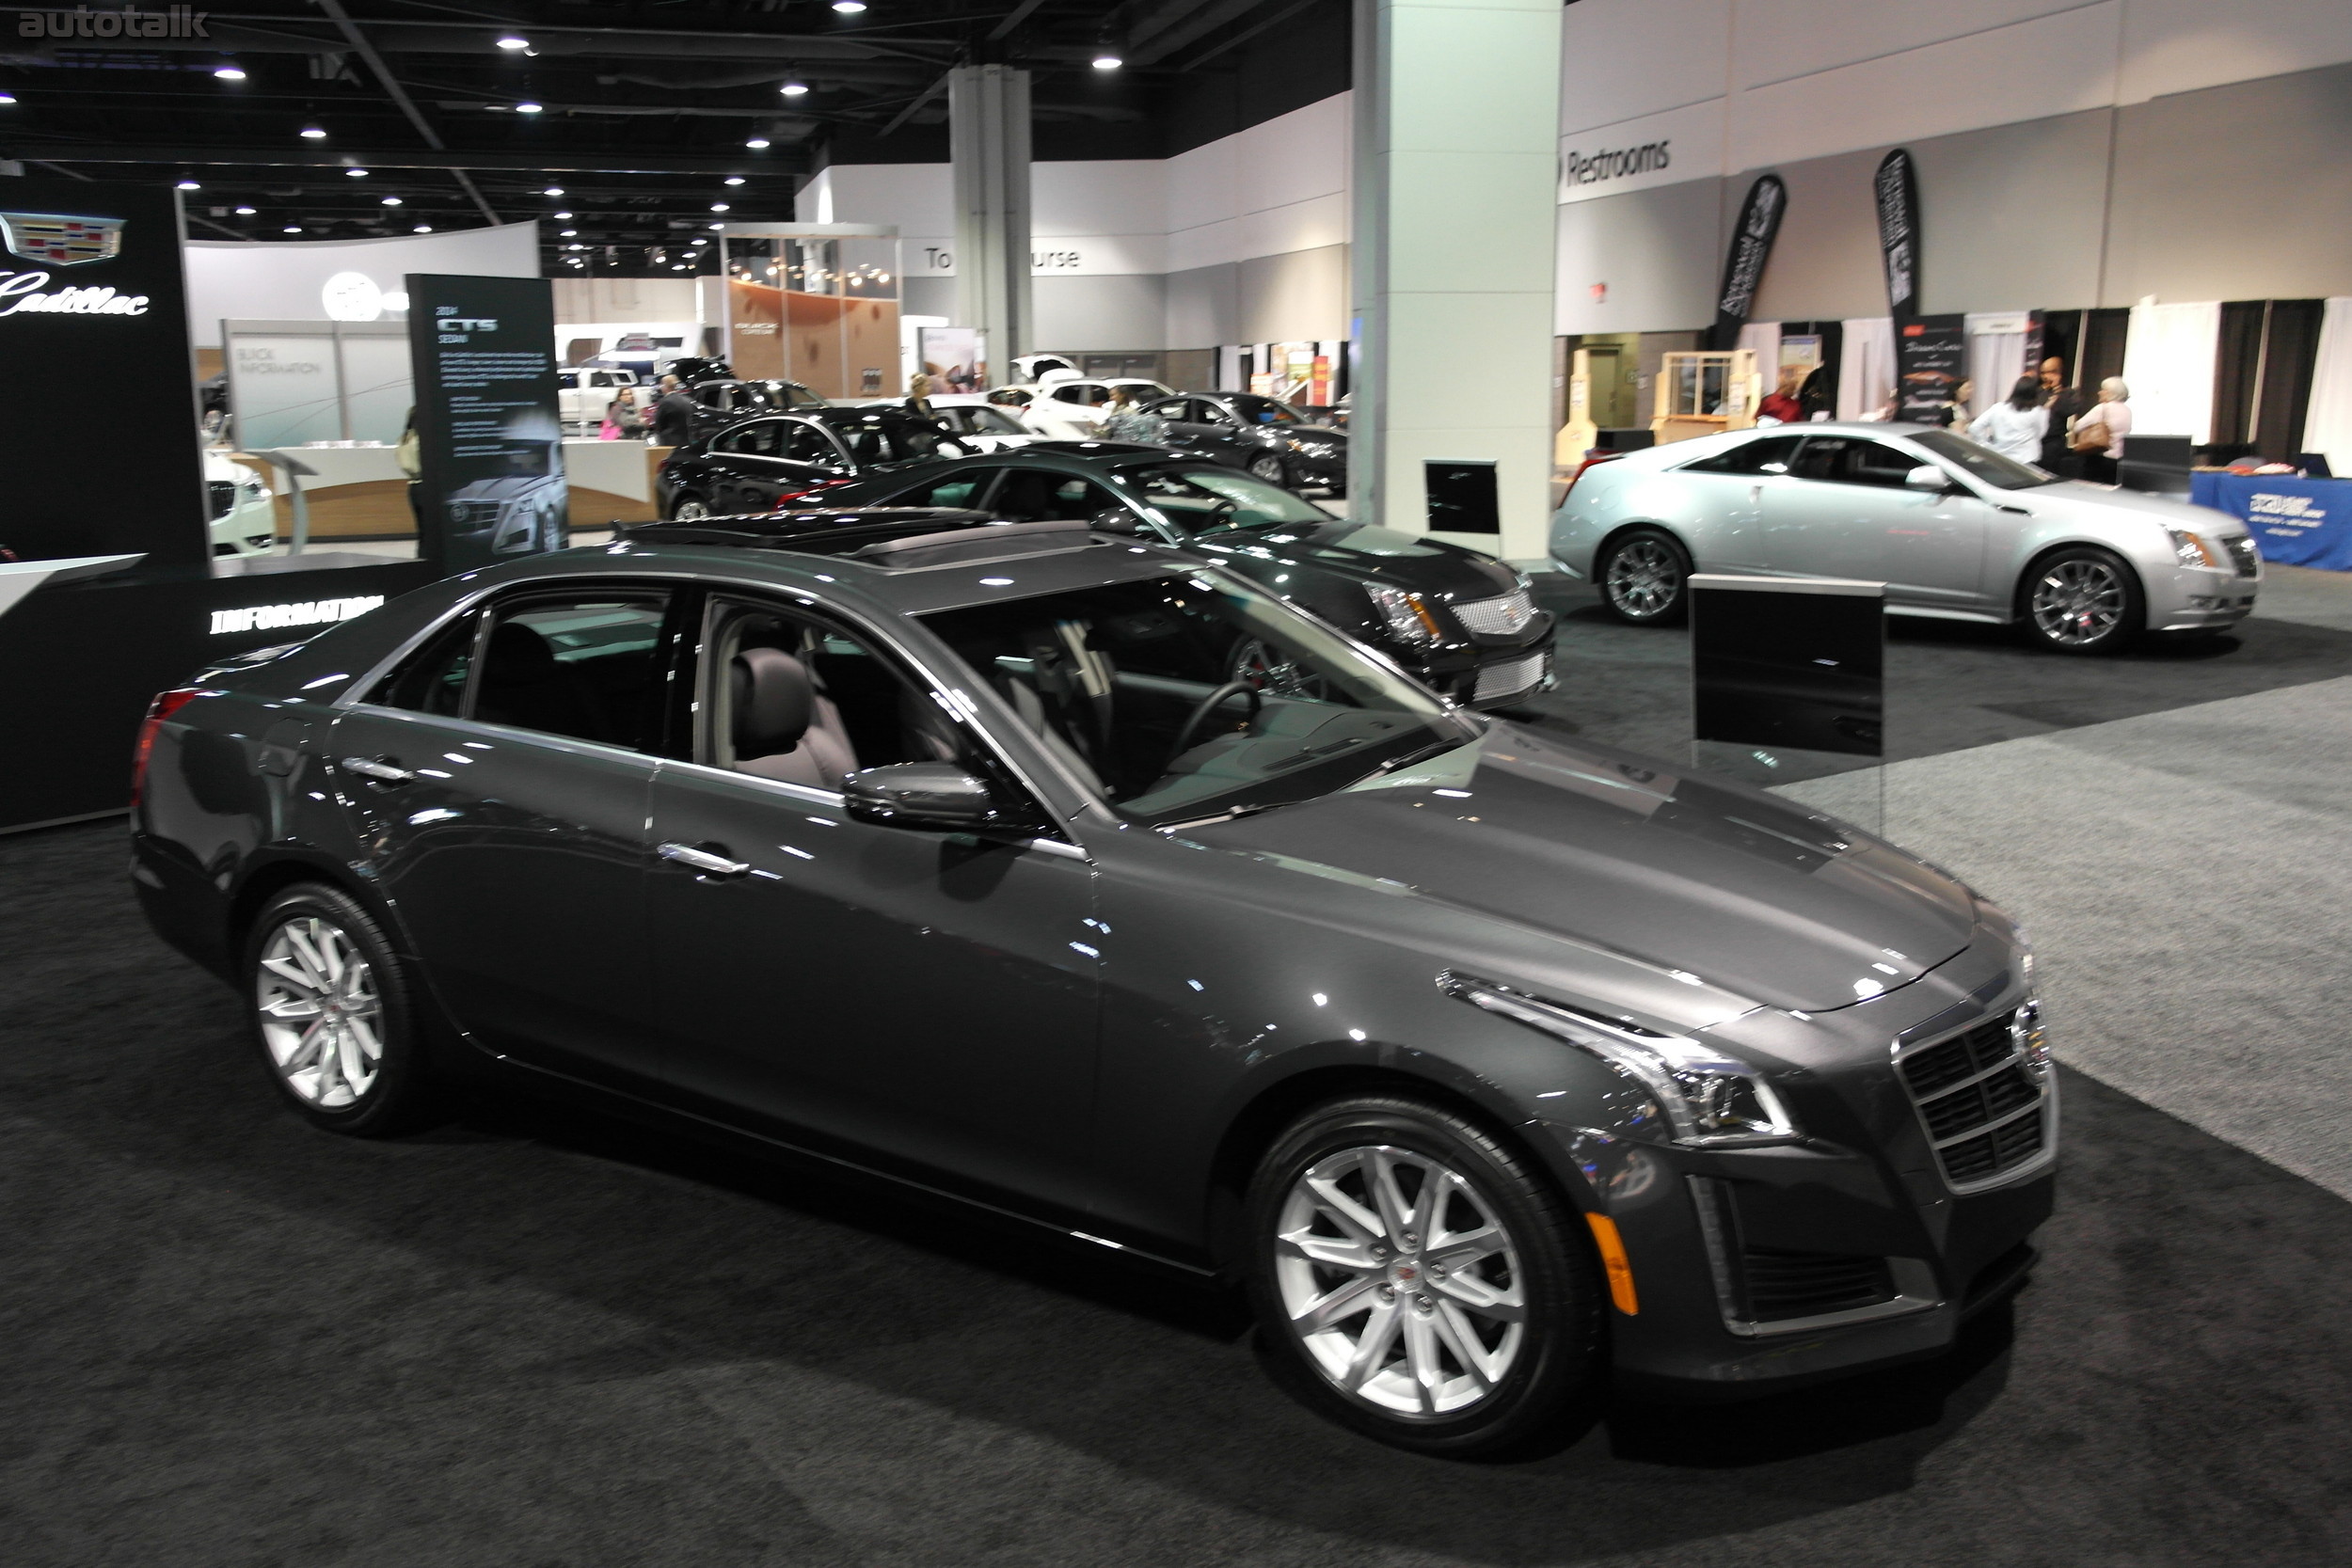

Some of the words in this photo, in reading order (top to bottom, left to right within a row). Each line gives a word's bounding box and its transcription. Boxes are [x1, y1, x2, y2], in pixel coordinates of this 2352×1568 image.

[1567, 140, 1670, 186] Restrooms
[924, 246, 952, 269] To
[1031, 250, 1082, 268] urse
[0, 271, 150, 316] Cadillac
[437, 319, 499, 331] CTS
[437, 334, 469, 344] SEDAN
[239, 361, 322, 374] INFORMATION
